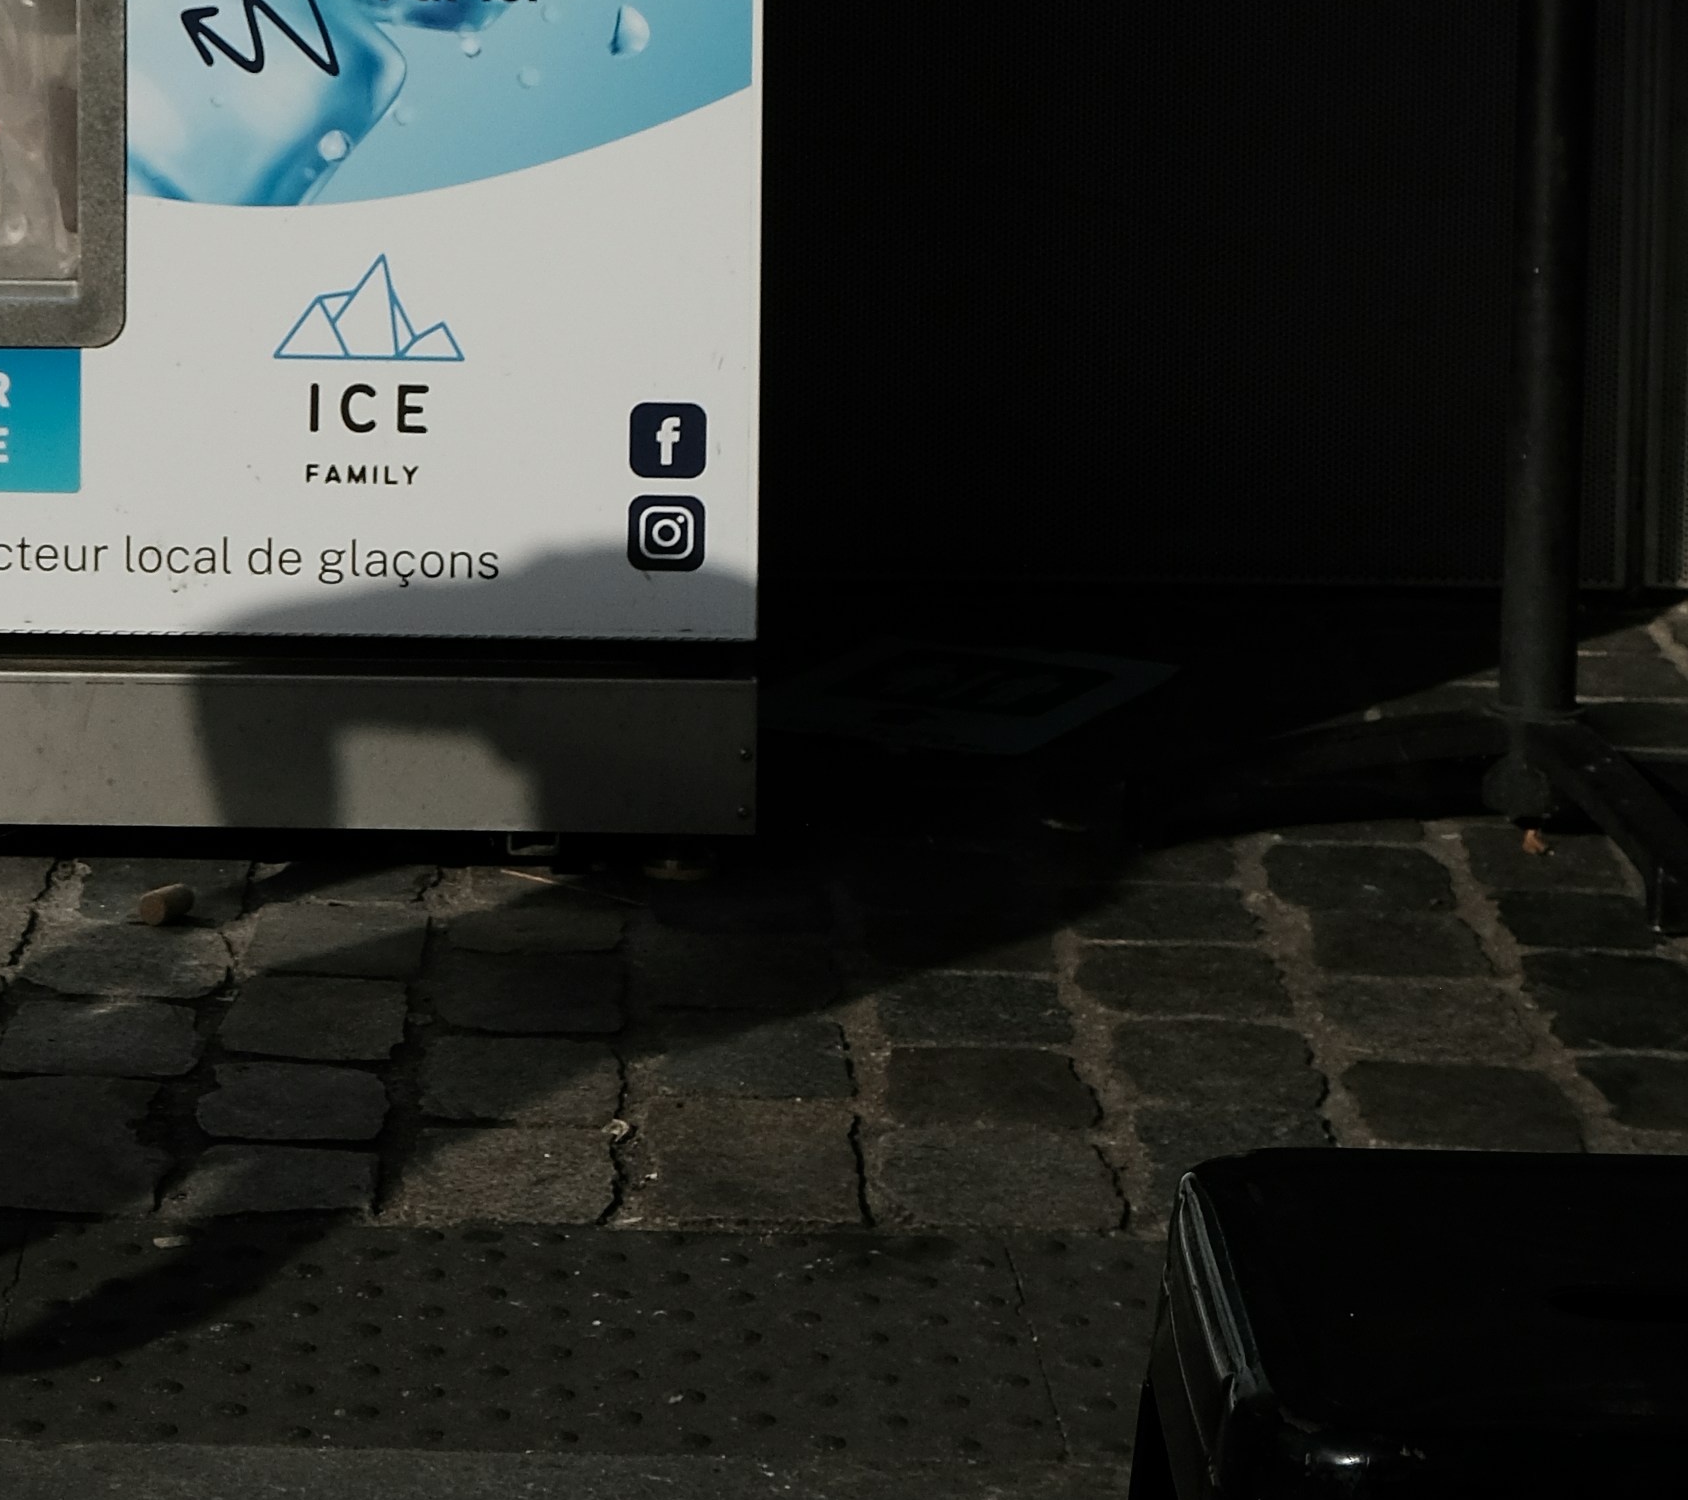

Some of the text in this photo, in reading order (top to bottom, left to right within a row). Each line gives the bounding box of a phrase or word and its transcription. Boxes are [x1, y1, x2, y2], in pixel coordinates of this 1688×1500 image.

[309, 382, 430, 434] ICE
[306, 463, 419, 485] FAMILY
[126, 535, 232, 575] local
[248, 537, 302, 576] de
[318, 539, 504, 594] glaçons
